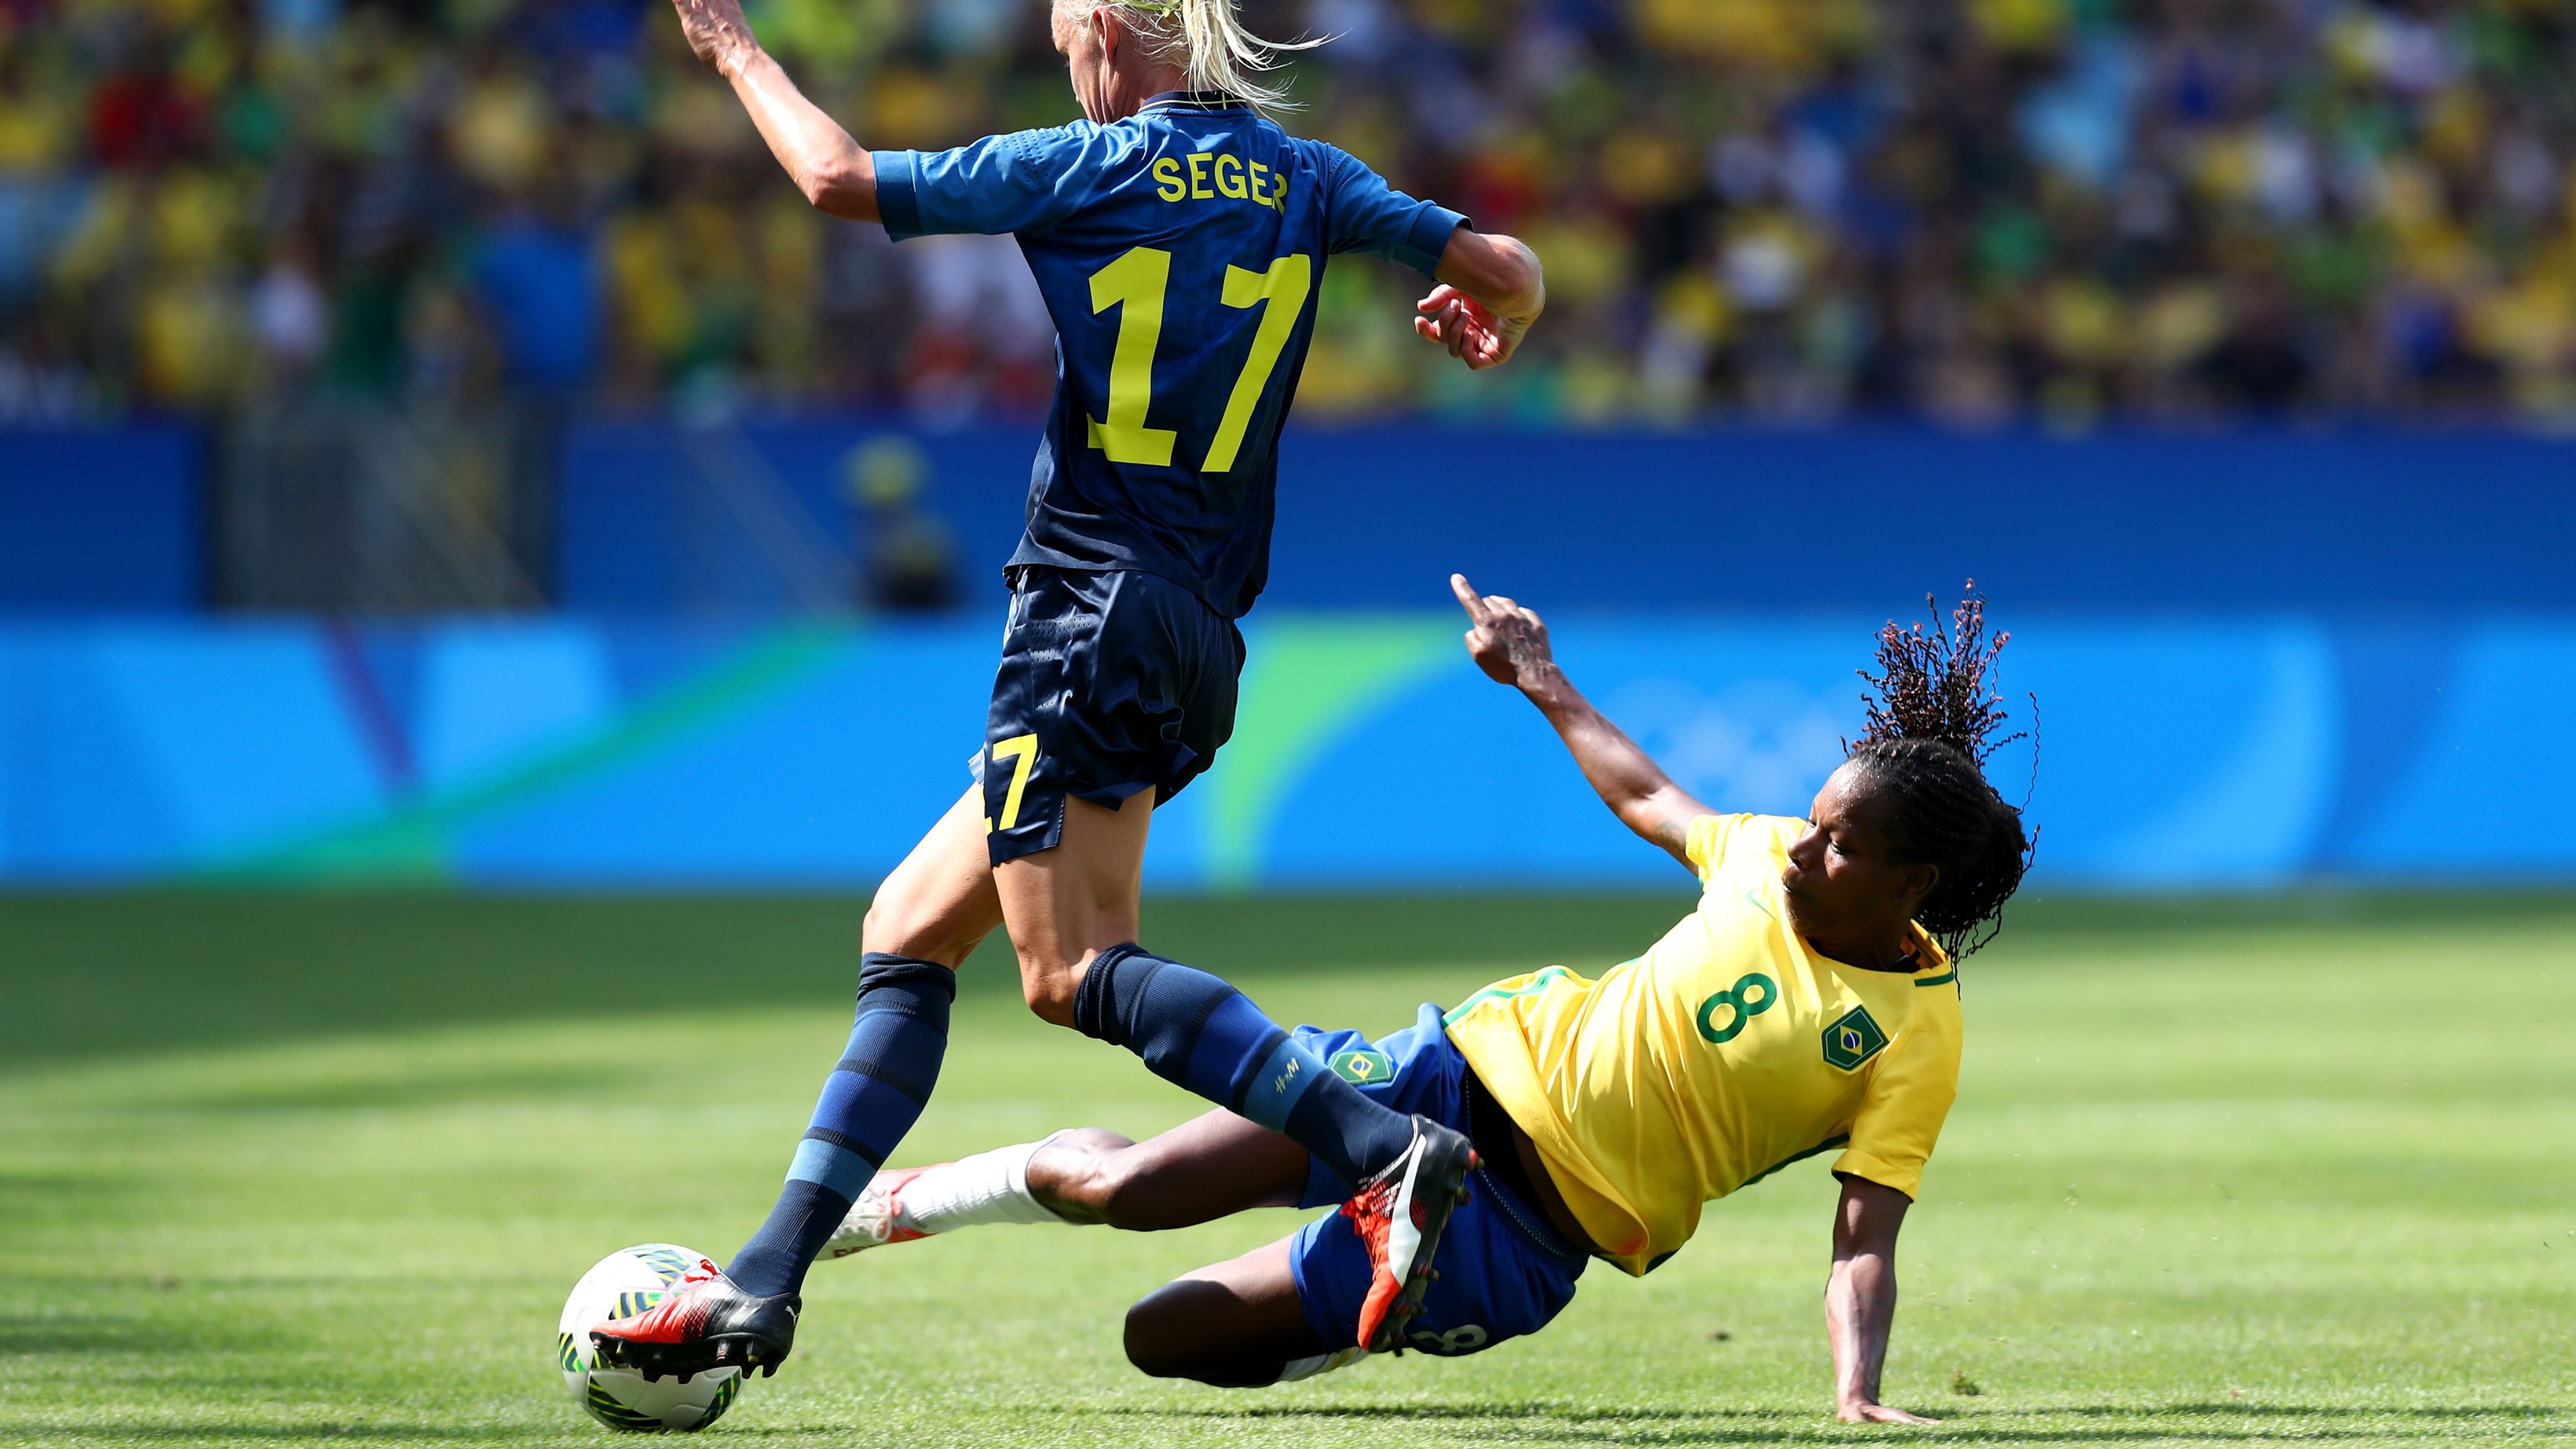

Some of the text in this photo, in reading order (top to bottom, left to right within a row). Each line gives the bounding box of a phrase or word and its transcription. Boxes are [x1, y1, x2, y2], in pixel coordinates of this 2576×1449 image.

[1152, 152, 1287, 216] SEGER
[1086, 245, 1311, 472] 17
[980, 732, 1038, 836] 7
[1696, 972, 1777, 1043] 8
